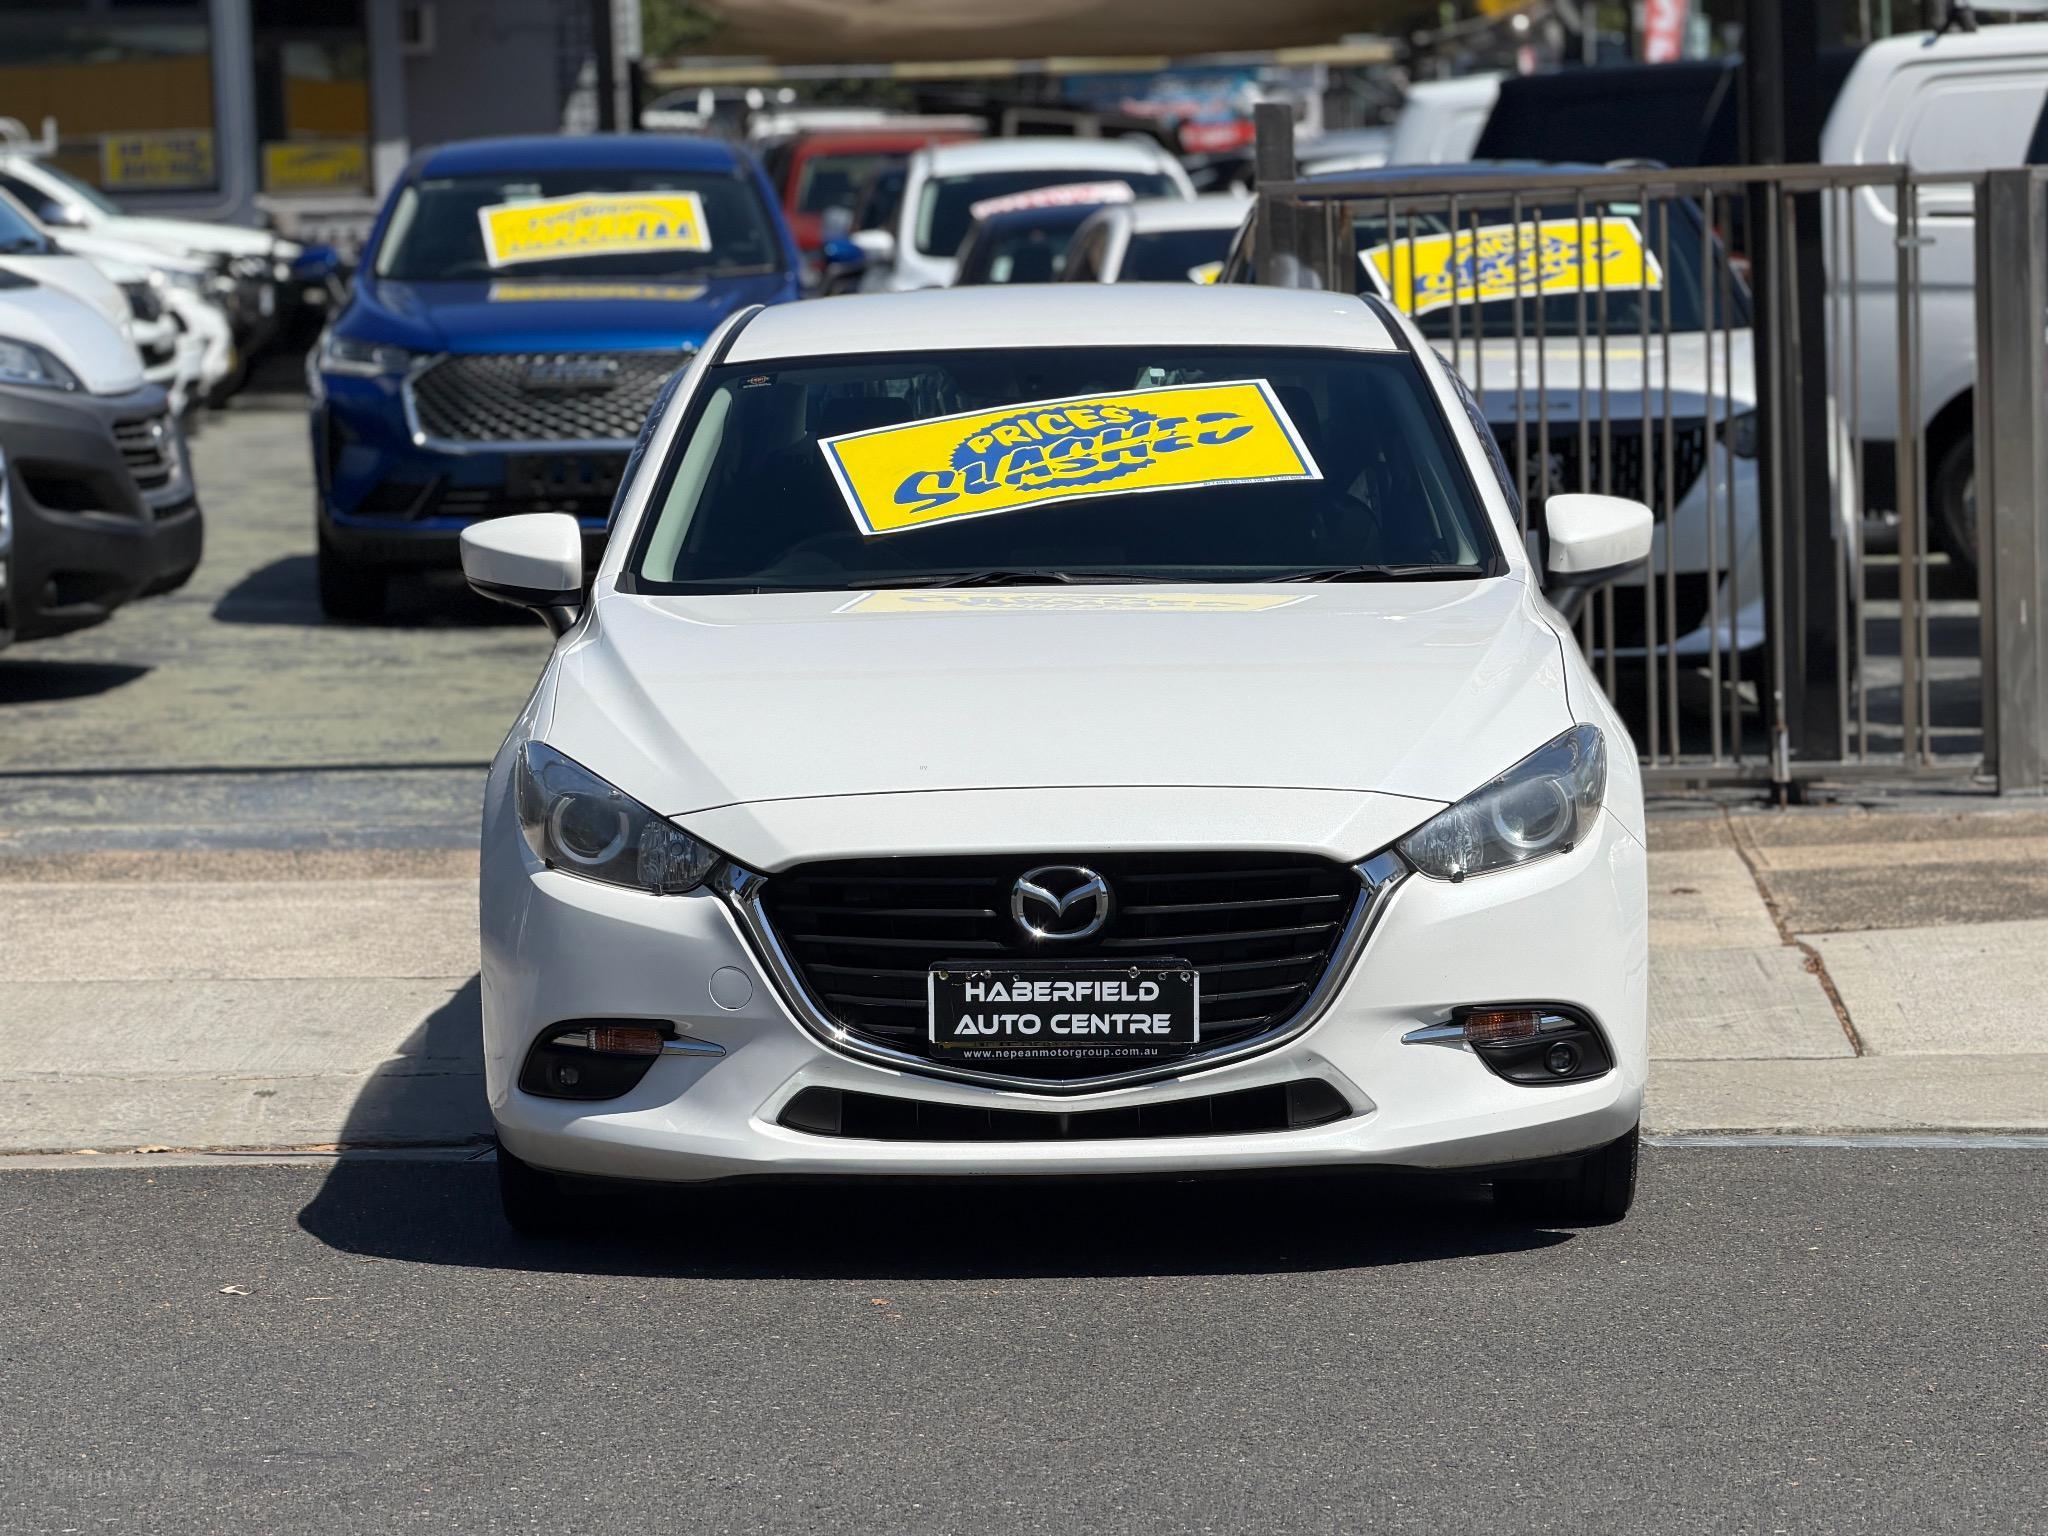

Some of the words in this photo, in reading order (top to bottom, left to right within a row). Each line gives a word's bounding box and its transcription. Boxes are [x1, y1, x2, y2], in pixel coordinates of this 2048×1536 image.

[967, 406, 1133, 453] PRICES
[893, 412, 1254, 514] SLASHED
[965, 981, 1160, 1002] HABERFIELD
[953, 1013, 1042, 1035] AUTO
[1050, 1013, 1172, 1035] CENTRE
[963, 1047, 1158, 1059] www.nepeanmotorgroup.com.au
